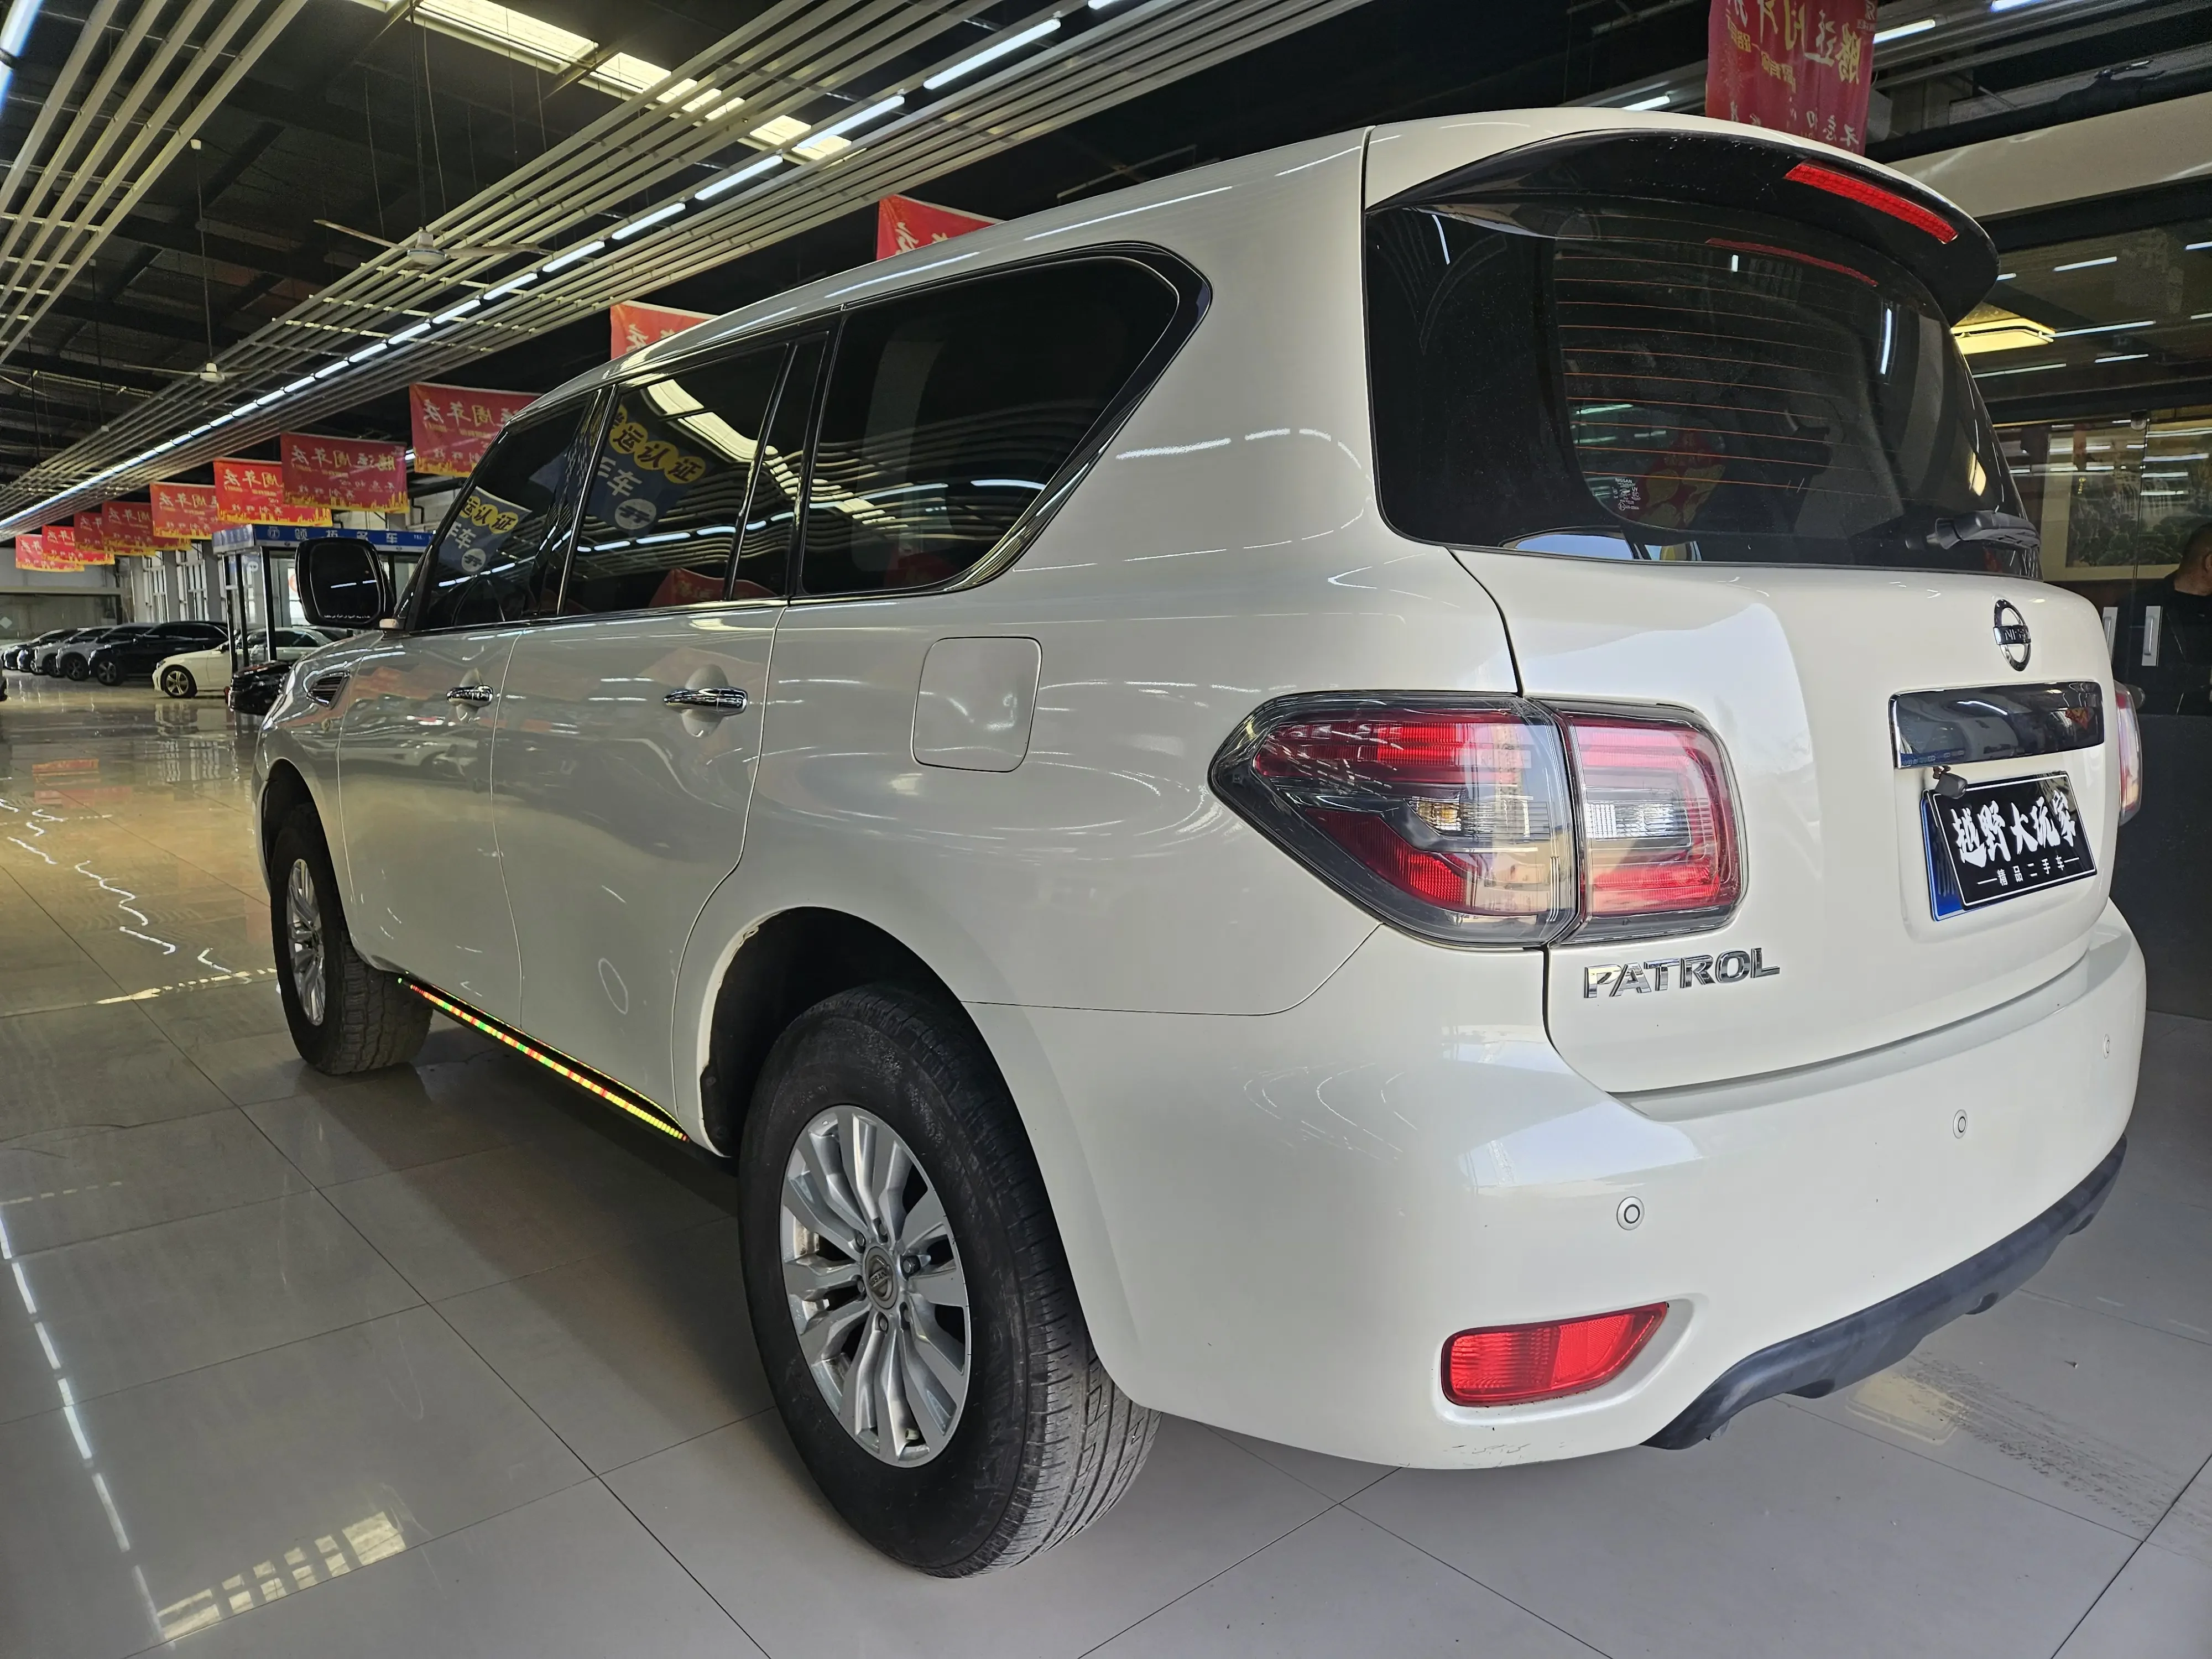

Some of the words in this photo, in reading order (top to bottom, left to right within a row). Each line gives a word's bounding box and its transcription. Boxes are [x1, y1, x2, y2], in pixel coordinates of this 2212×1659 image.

[1950, 790, 2076, 868] 越野大玩家
[1997, 855, 2064, 886] 精品二手车
[1584, 947, 1780, 998] PATROL
